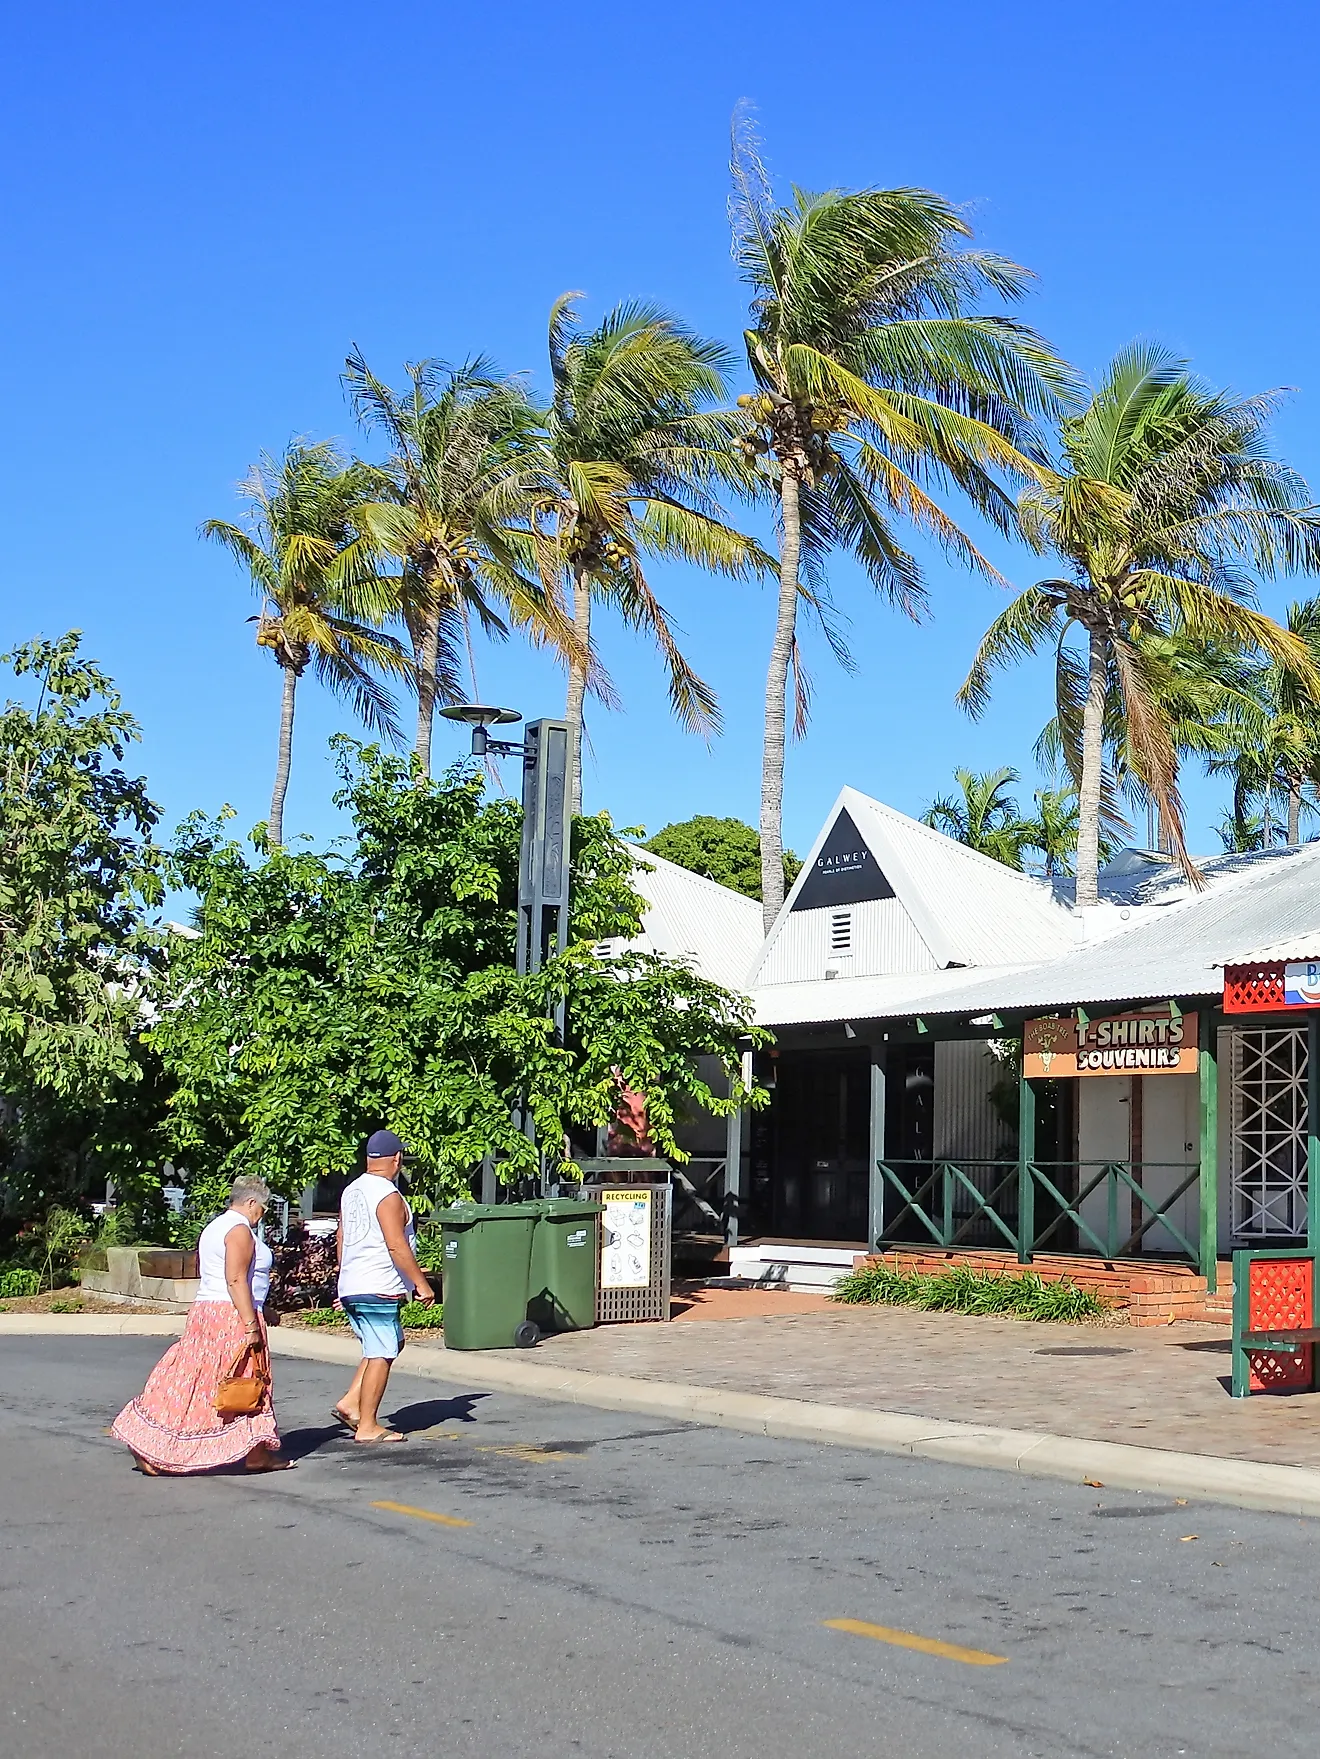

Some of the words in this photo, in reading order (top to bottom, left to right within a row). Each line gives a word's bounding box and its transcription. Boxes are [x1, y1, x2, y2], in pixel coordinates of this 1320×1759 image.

[817, 850, 868, 867] GALWEY
[1075, 1018, 1184, 1048] T-SHIRTS
[1077, 1047, 1181, 1070] SOUVENIRS
[606, 1193, 648, 1201] RECYCLING
